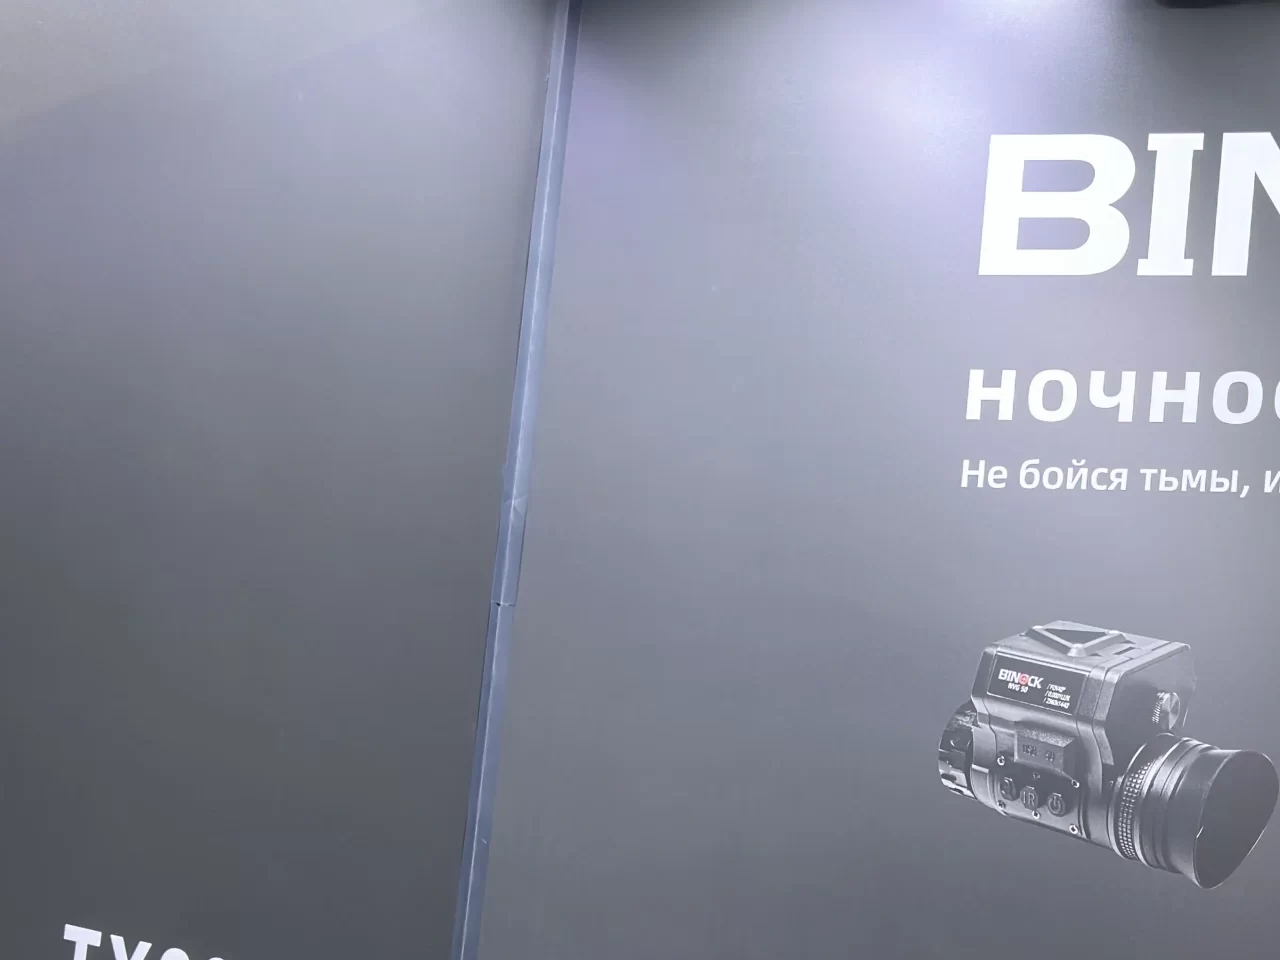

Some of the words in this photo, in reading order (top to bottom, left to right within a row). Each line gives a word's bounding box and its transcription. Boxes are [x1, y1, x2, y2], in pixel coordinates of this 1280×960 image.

[961, 460, 1008, 489] Не
[1019, 459, 1129, 491] бойся
[1139, 468, 1250, 497] тьмы,
[998, 669, 1044, 688] BINOCK
